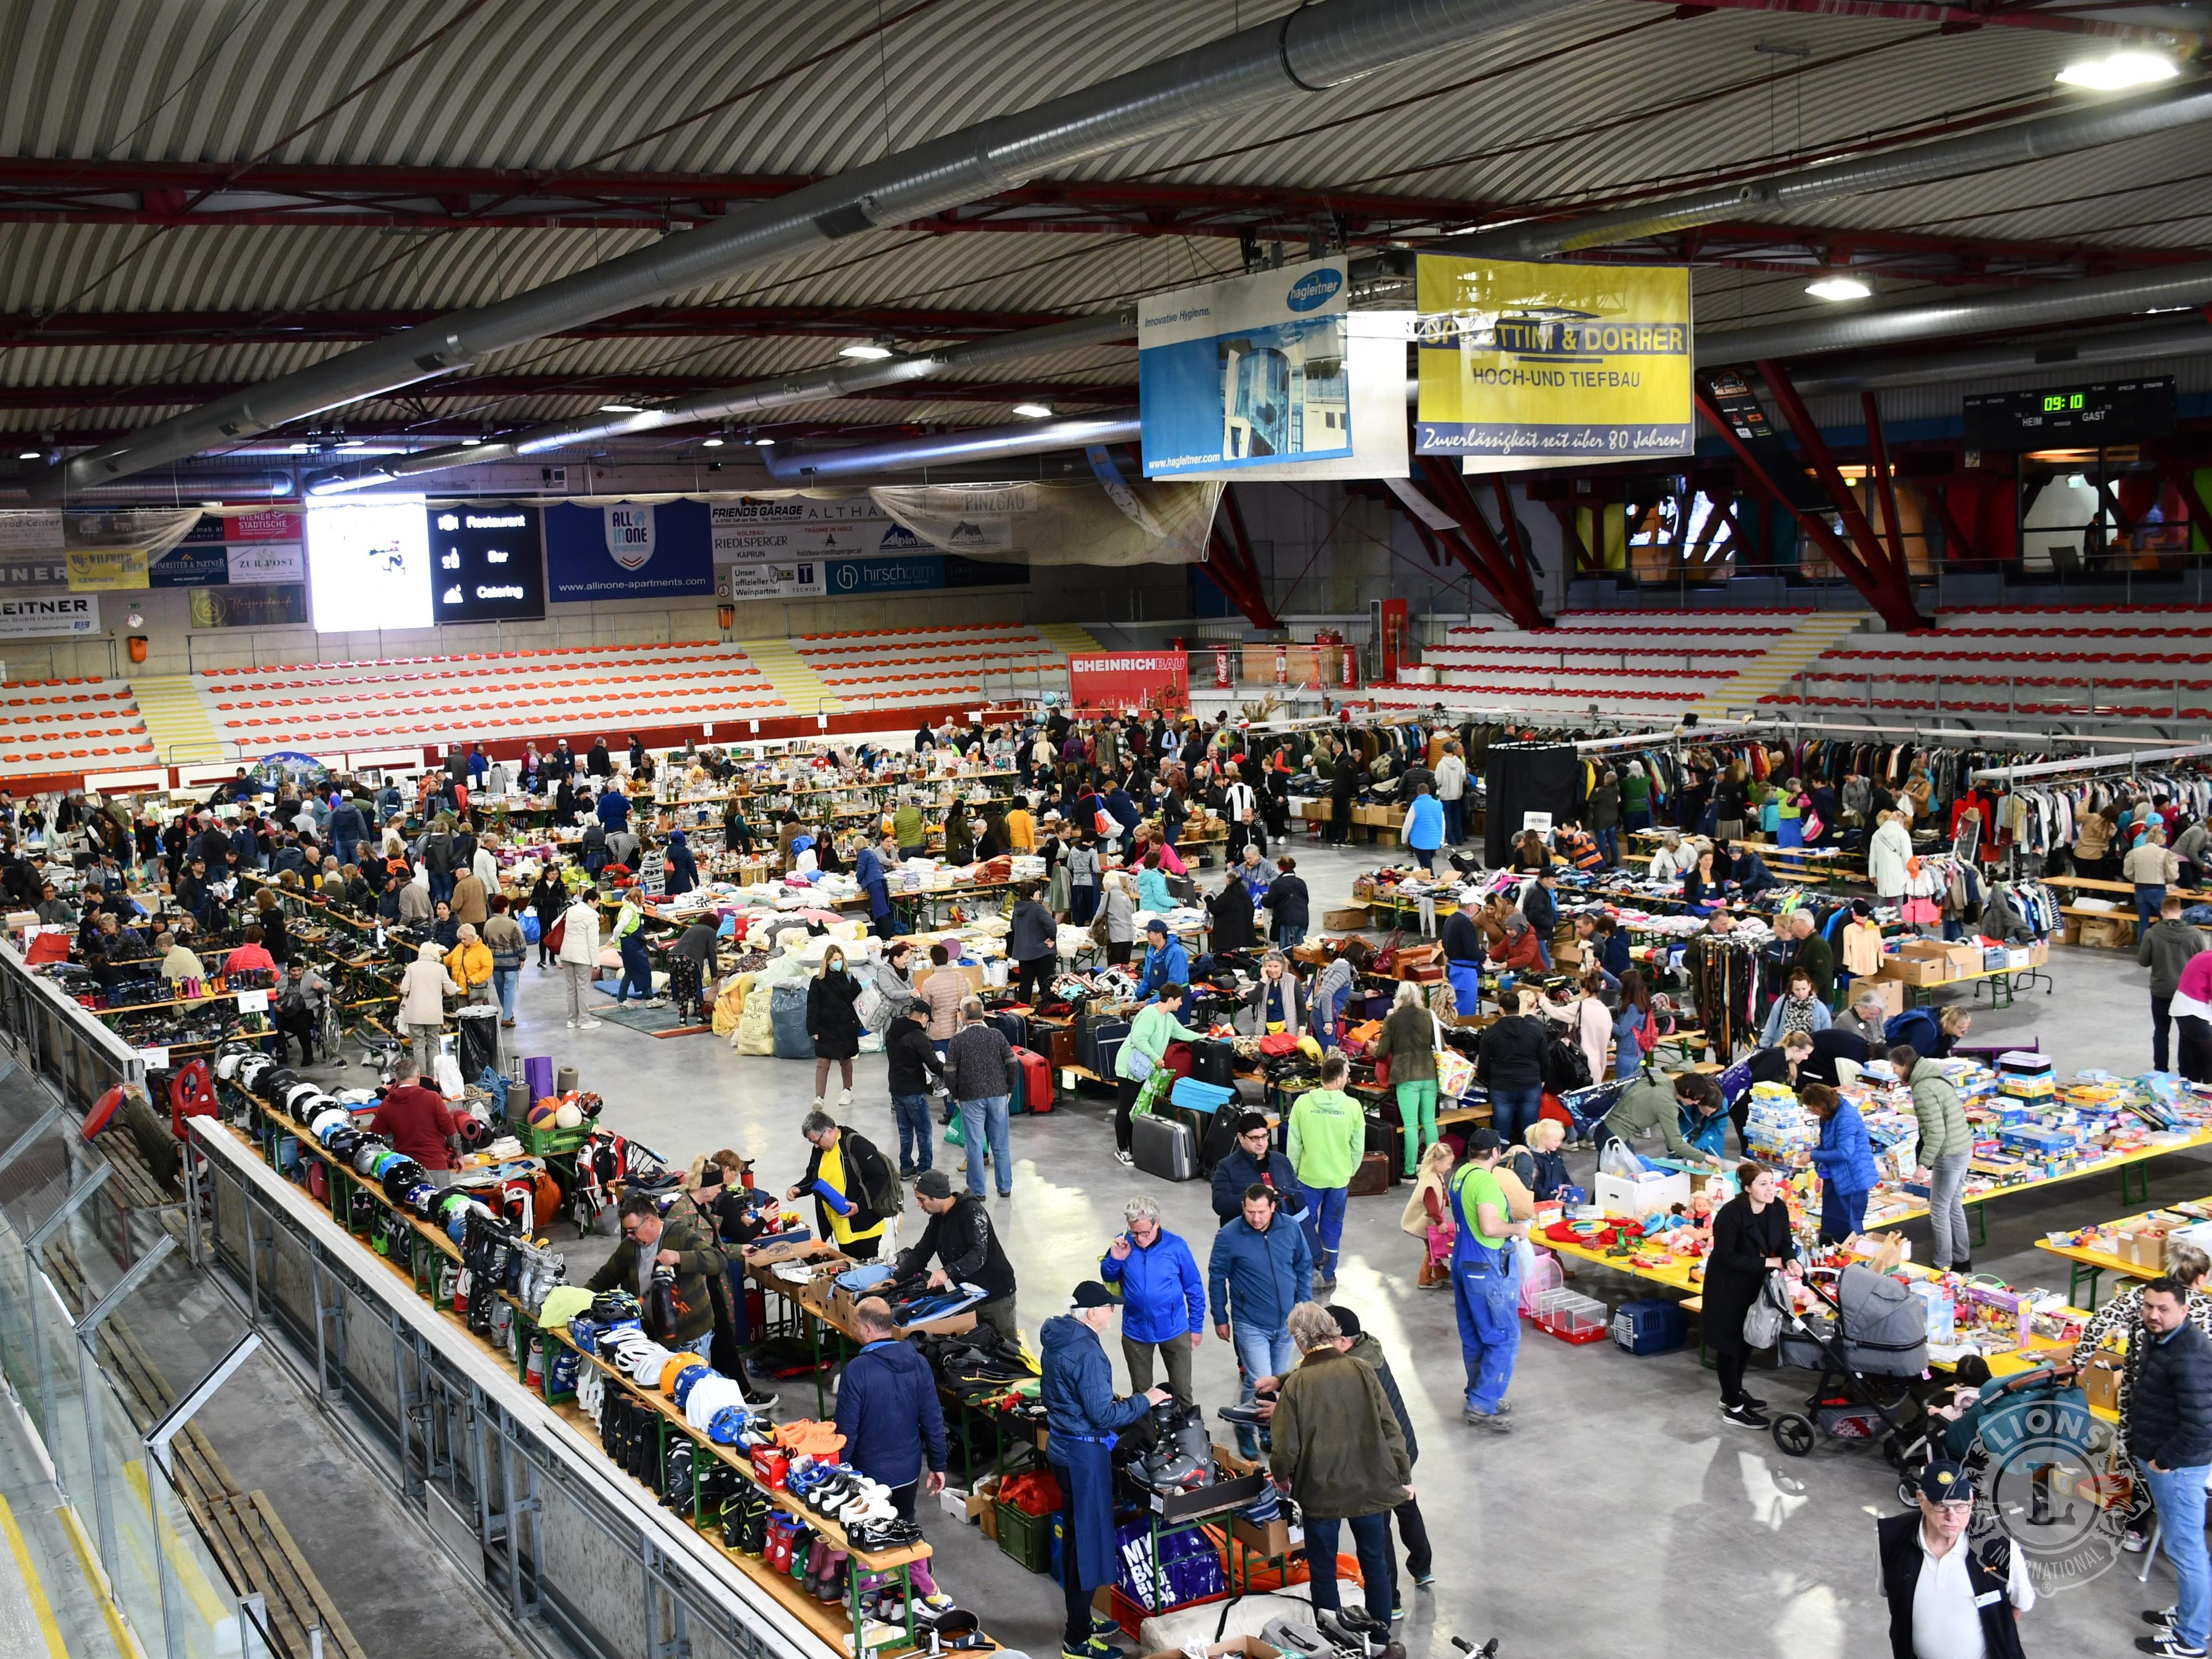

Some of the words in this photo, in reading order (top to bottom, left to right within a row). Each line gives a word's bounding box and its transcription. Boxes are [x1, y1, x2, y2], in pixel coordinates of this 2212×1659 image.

[1290, 280, 1339, 301] hagleitner
[1145, 314, 1177, 328] Innovative
[1179, 306, 1211, 322] Hygiene.
[1562, 327, 1577, 351] &
[1585, 327, 1683, 351] DORRER
[1473, 368, 1565, 387] HOCH-UND
[1569, 371, 1640, 388] TIEFBAU
[2044, 393, 2083, 411] 09:10
[2022, 417, 2042, 426] HEIM
[2082, 411, 2105, 421] GAST
[1422, 427, 1541, 455] Zuverlässigkeit
[1541, 429, 1571, 447] seit
[1572, 429, 1605, 449] über
[1608, 431, 1629, 450] 80
[1633, 429, 1686, 449] Jahren!
[1149, 452, 1220, 470] www.hagleitner.com
[239, 513, 271, 521] WIENER
[712, 507, 758, 518] FRIENDS
[759, 505, 803, 516] GARAGE
[613, 512, 633, 527] ALL
[715, 536, 787, 549] RIEDLSPERGER
[151, 561, 188, 570] WIMREITER
[196, 558, 225, 568] PARTNER
[265, 558, 294, 567] POST
[488, 550, 509, 563] Bar
[864, 564, 934, 581] hirschcom
[559, 578, 706, 592] www.allinone-apartments.com
[735, 578, 769, 587] offizieller
[477, 585, 523, 599] Catering
[735, 588, 780, 597] Weinpartner
[0, 600, 88, 615] EITNER
[1217, 654, 1227, 683] Coca-Cola
[744, 1012, 762, 1021] SACK
[746, 1004, 769, 1014] GELBE
[1122, 1531, 1152, 1567] MY
